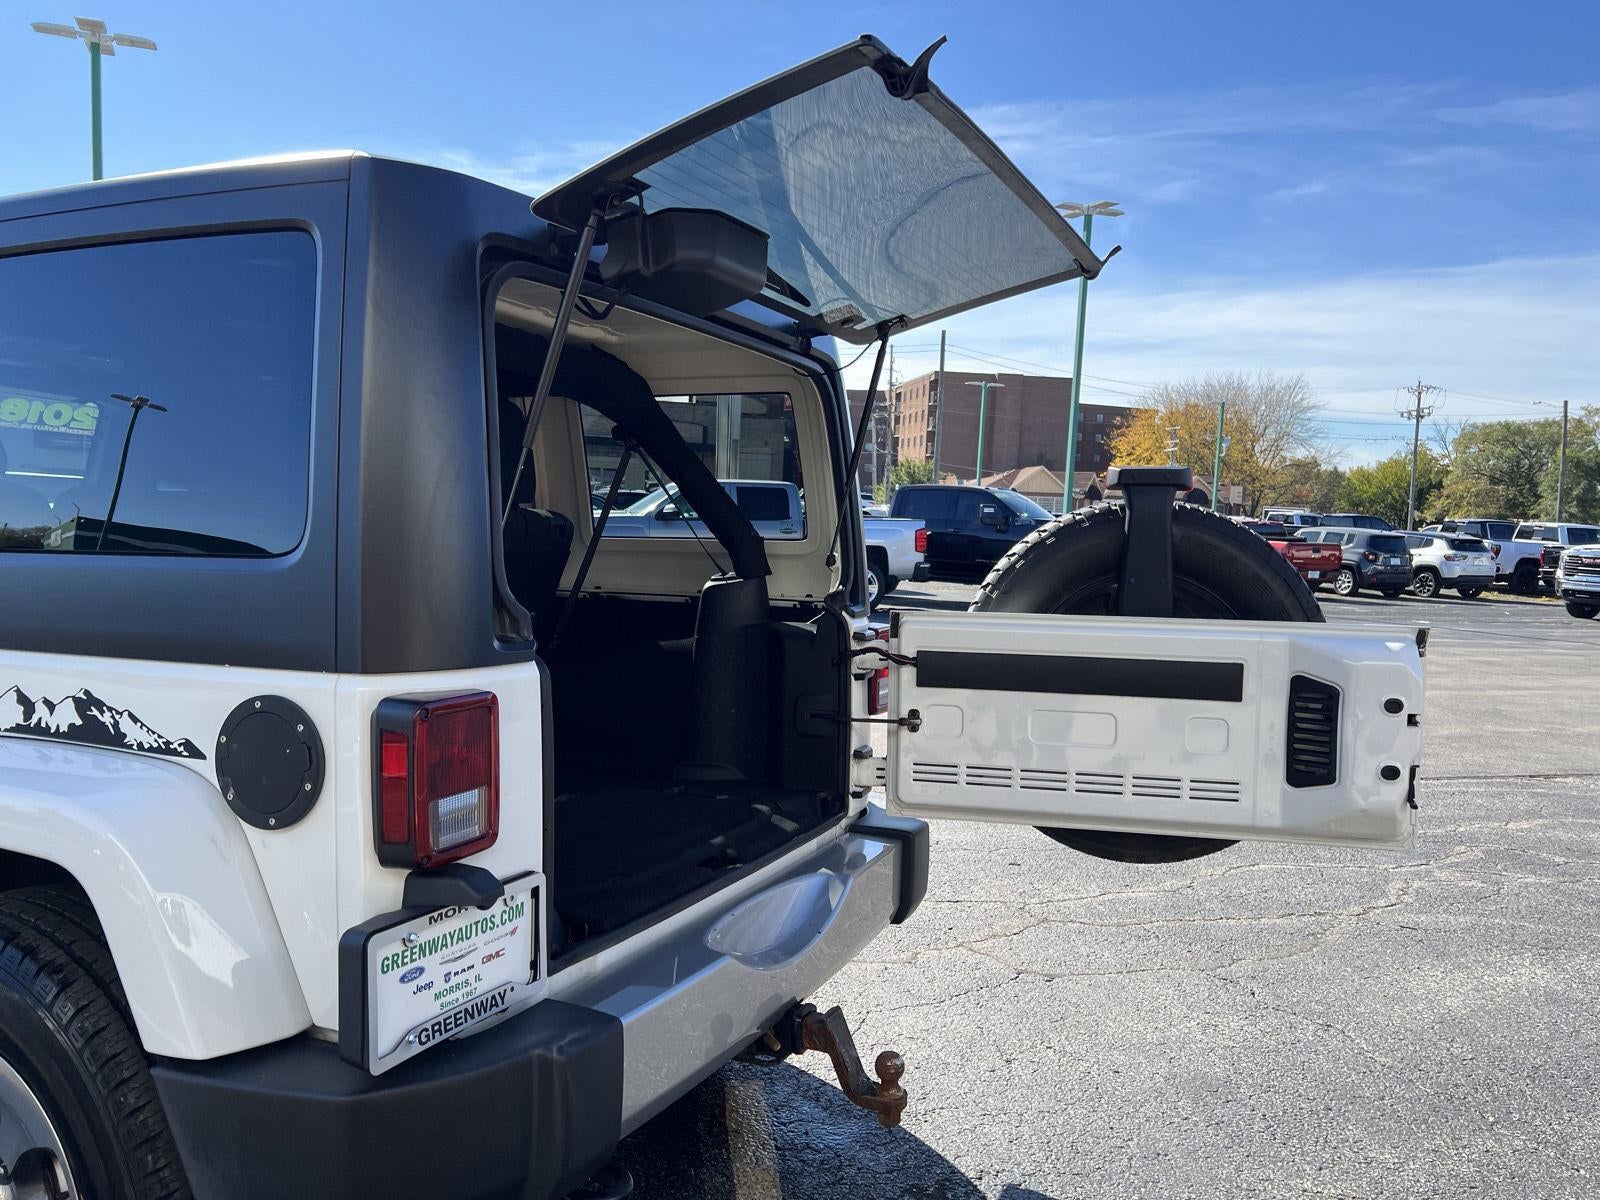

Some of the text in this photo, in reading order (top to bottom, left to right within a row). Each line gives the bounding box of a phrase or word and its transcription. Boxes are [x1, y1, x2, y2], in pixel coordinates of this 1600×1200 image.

[381, 901, 525, 975] GREENWAYAUTOS.COM
[481, 948, 506, 965] GMC
[454, 964, 475, 977] RAM
[412, 981, 434, 995] Jeep
[434, 973, 483, 1002] MORRIS, IL
[440, 987, 478, 1011] Since 1967
[418, 990, 508, 1046] GREENWAY
